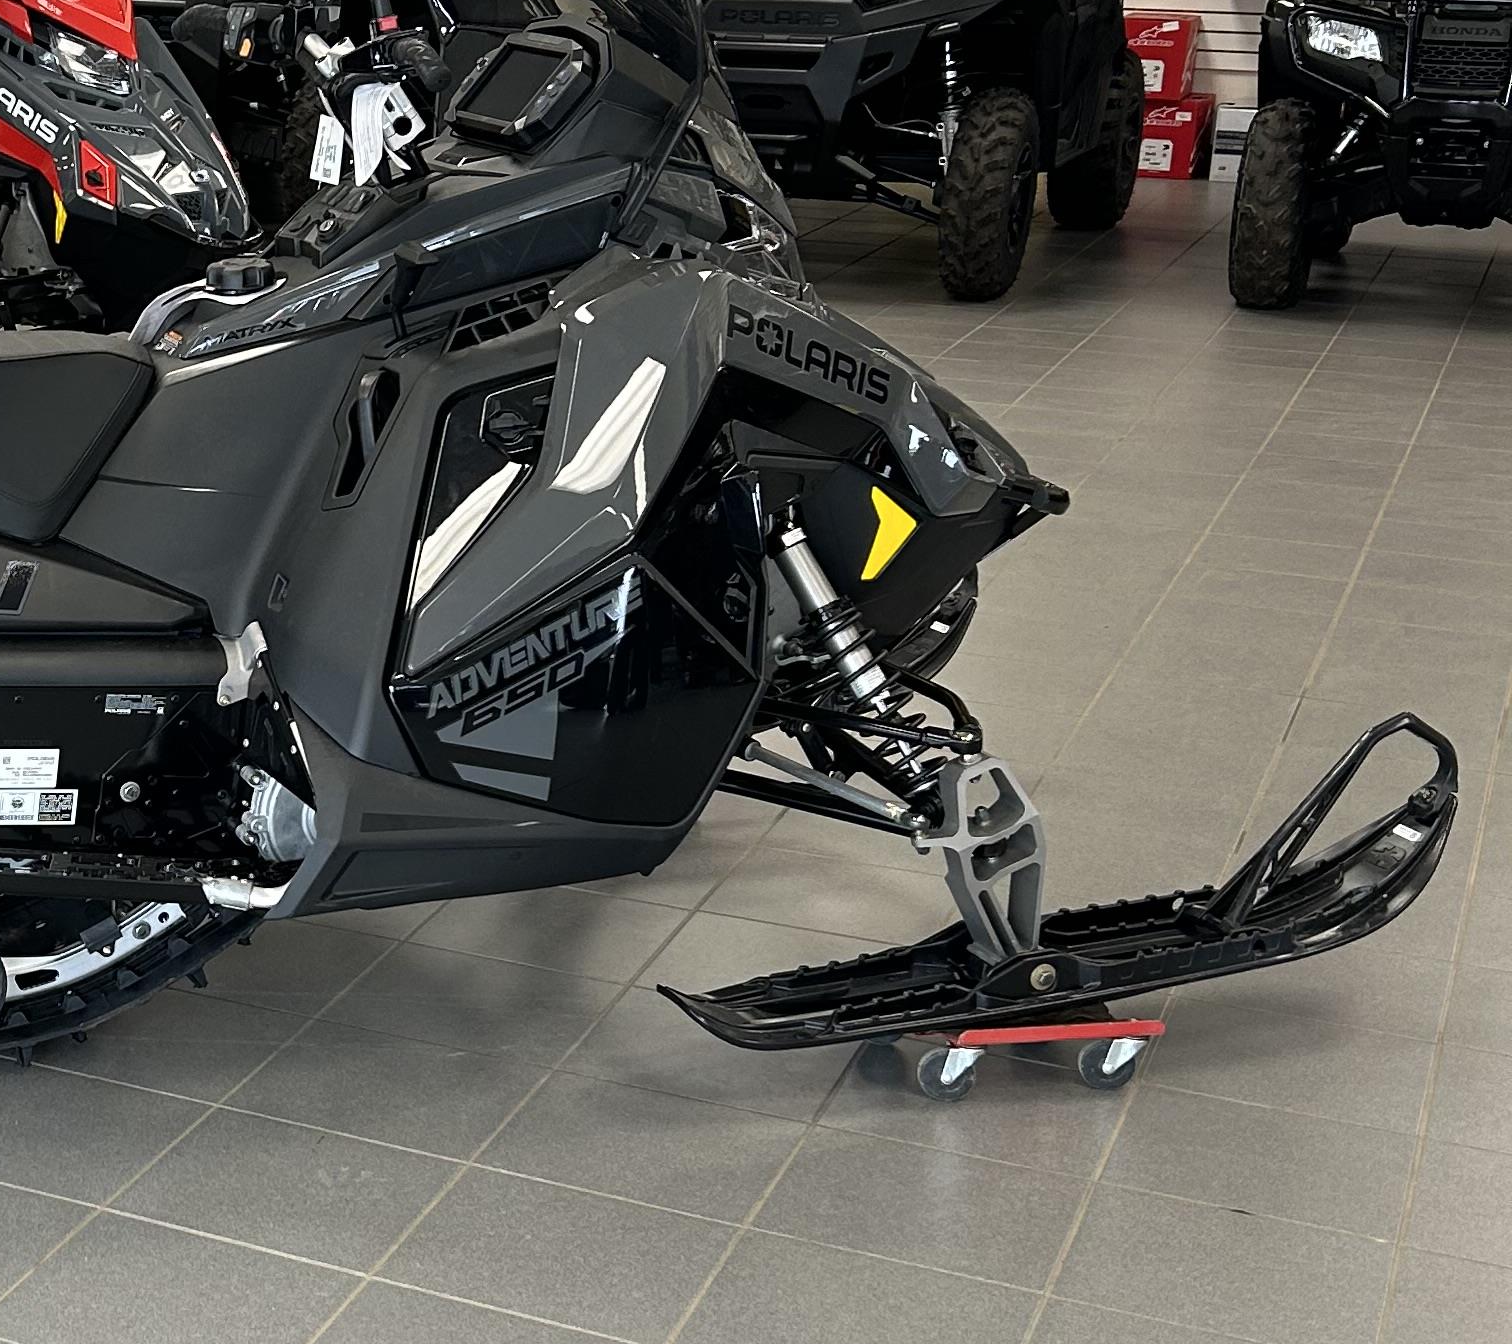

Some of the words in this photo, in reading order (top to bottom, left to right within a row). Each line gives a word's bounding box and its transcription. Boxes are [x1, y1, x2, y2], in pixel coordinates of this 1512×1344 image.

[1431, 26, 1504, 37] HONDA
[190, 316, 297, 354] MATRYX
[726, 303, 890, 405] POLARIS
[425, 573, 644, 720] ADVENTURE
[460, 648, 586, 738] 650
